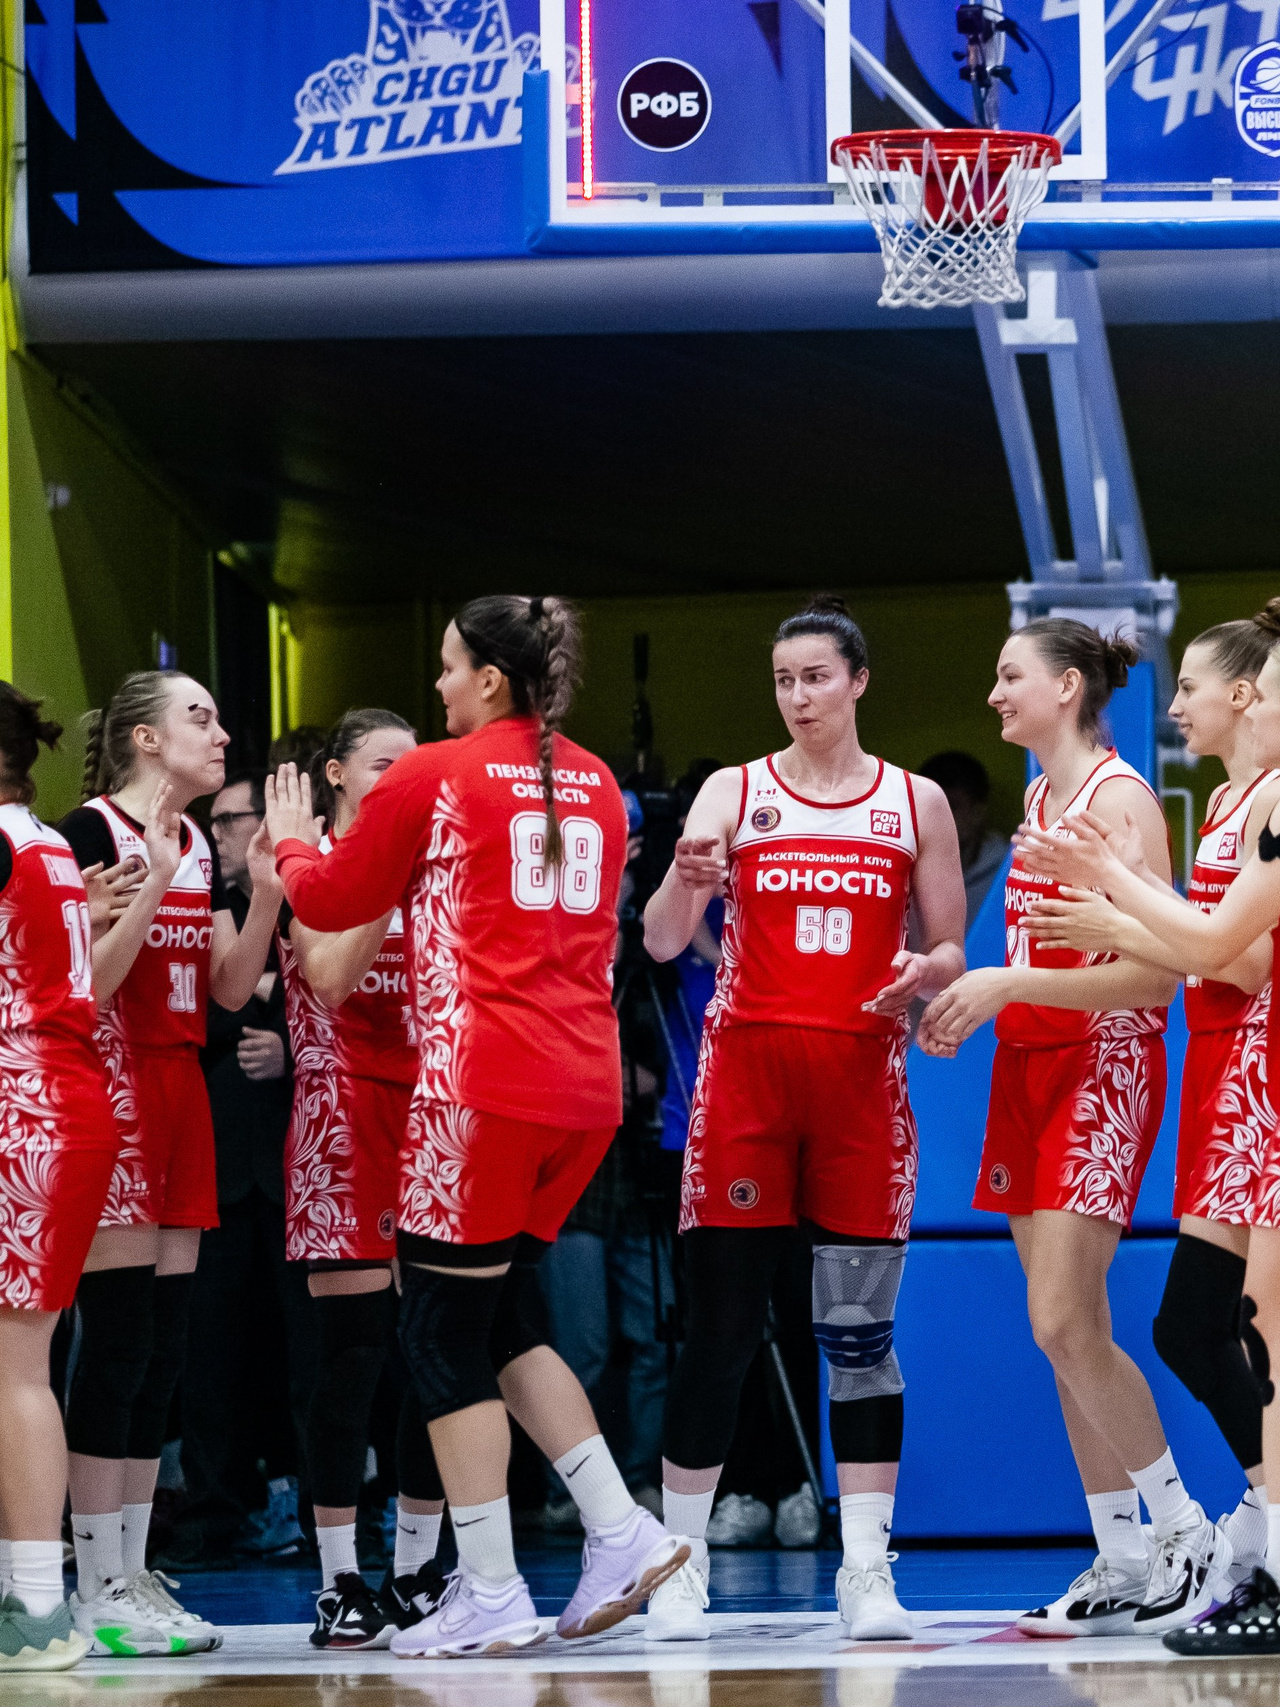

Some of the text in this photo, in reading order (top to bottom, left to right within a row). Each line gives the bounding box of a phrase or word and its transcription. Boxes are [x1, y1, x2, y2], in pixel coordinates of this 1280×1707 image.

[371, 57, 508, 107] CHGU
[630, 92, 700, 118] РФБ
[292, 96, 523, 164] ATLAN
[872, 812, 899, 824] FON
[873, 821, 899, 835] BET
[509, 811, 603, 915] 88
[758, 852, 893, 868] БАСКЕТБОЛЬНЫЙ КЛУБ
[756, 868, 892, 898] ЮНОСТЬ
[795, 905, 852, 956] 58
[168, 962, 197, 1013] 30
